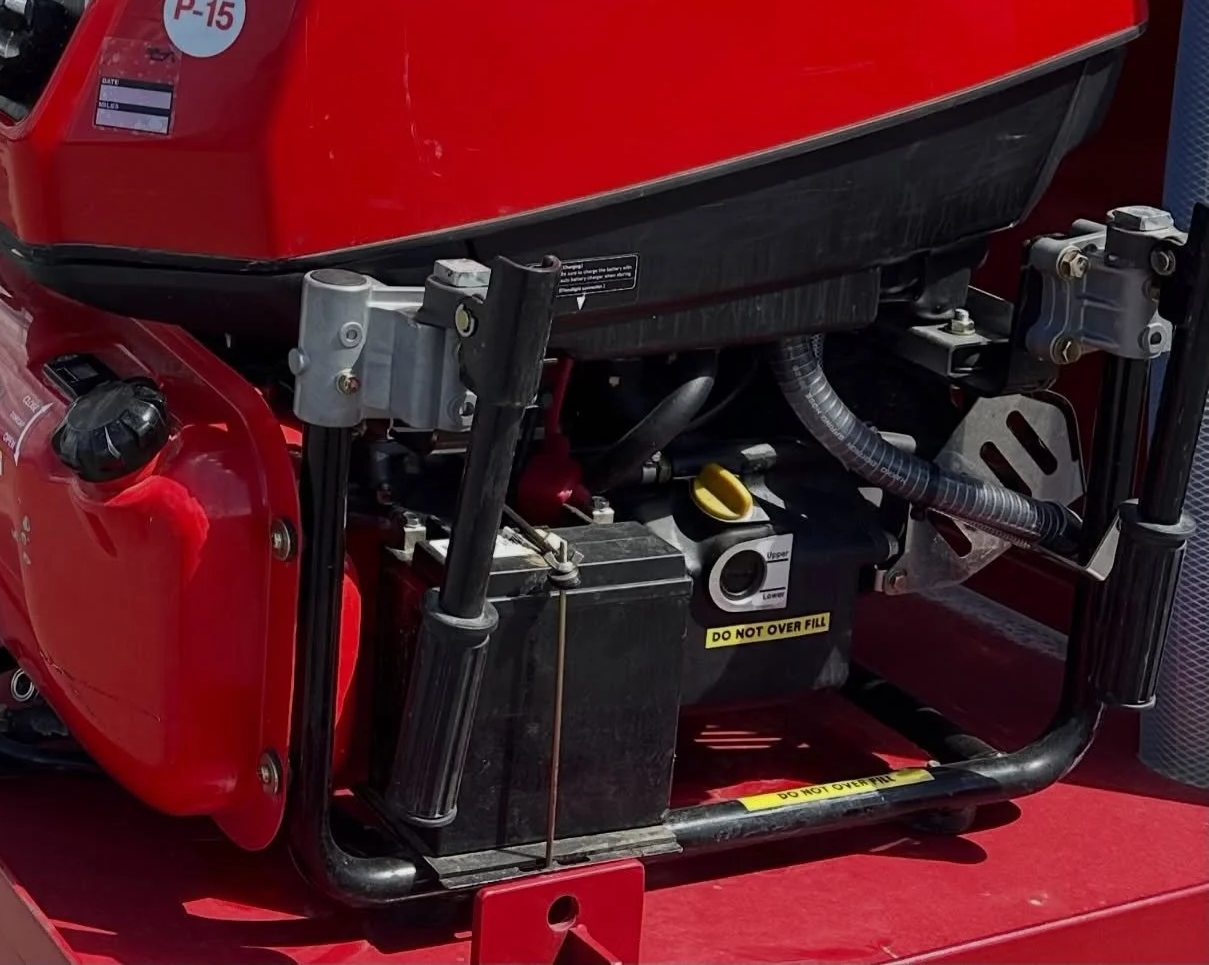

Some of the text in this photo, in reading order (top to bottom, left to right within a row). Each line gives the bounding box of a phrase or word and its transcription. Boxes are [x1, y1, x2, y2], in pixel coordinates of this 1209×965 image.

[2, 432, 16, 449] OPEN
[766, 550, 789, 560] Upper
[763, 592, 785, 600] Lower
[712, 617, 826, 642] DO NOT OVER FILL
[778, 775, 896, 800] DO NOT OVER FILL
